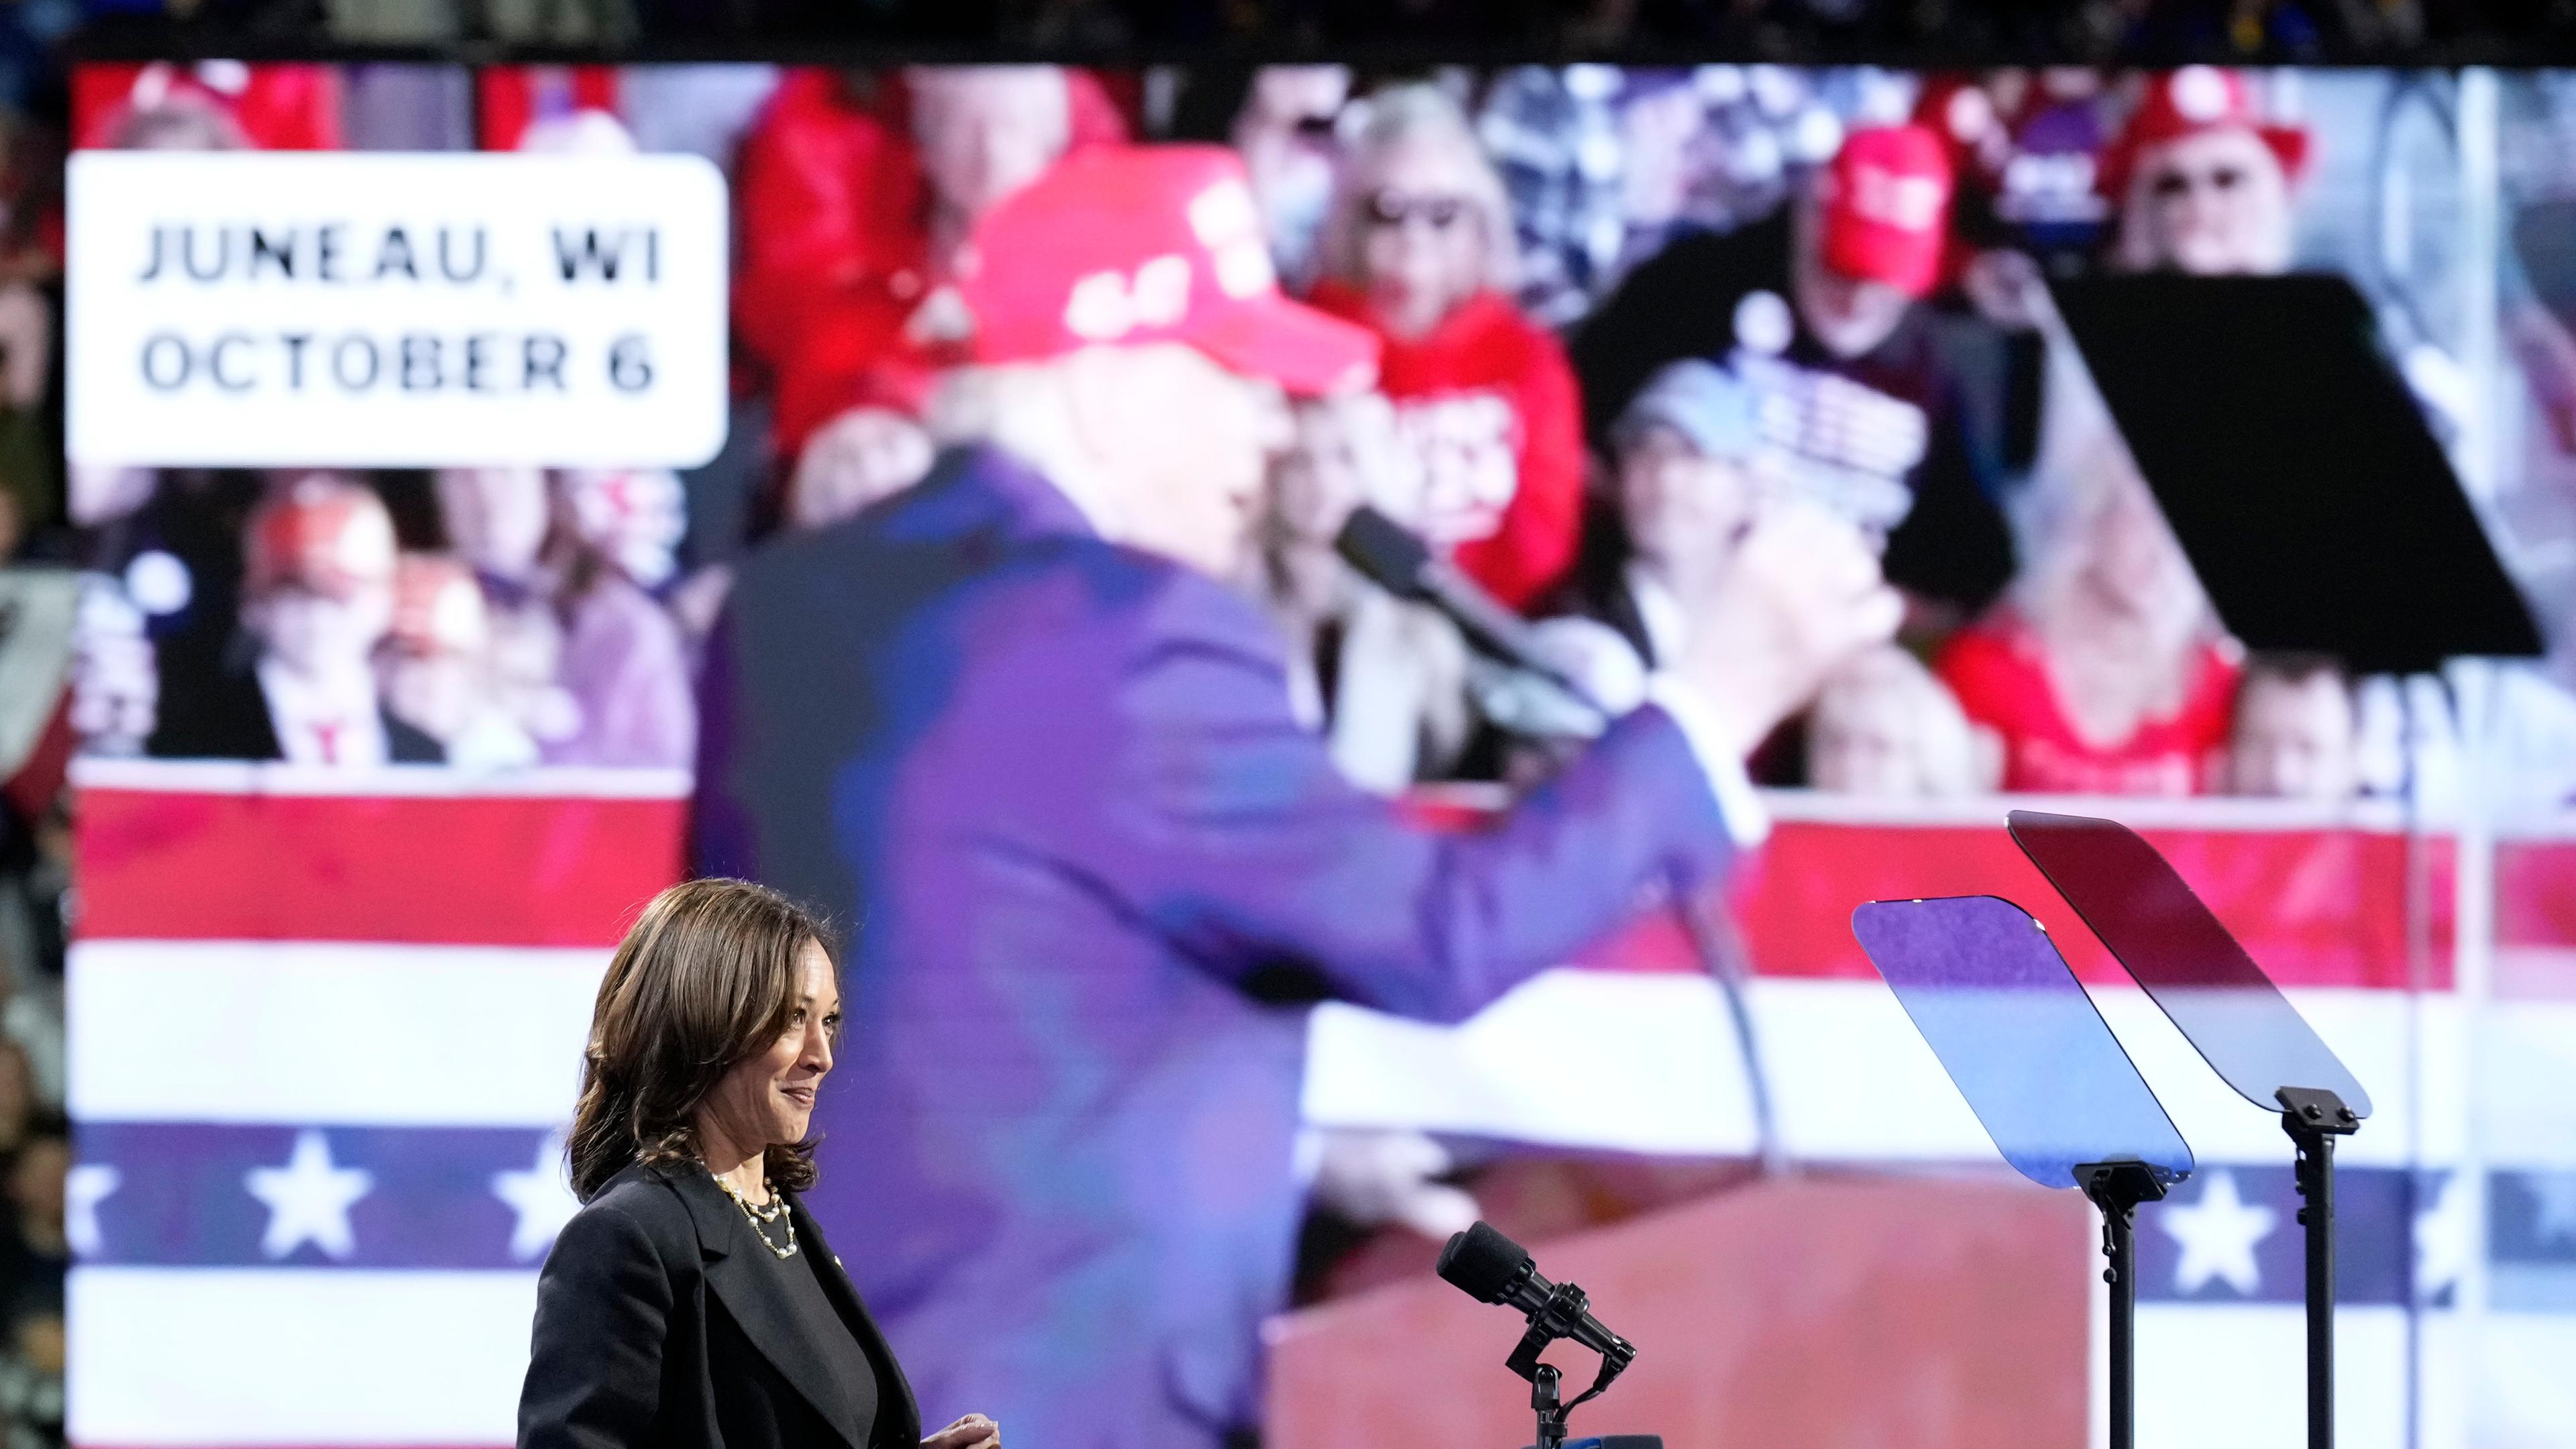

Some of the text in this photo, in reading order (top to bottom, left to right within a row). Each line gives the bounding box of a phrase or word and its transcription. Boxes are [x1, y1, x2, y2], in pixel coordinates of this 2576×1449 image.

[138, 225, 659, 295] JUNEAU, WI
[140, 334, 655, 392] OCTOBER 6
